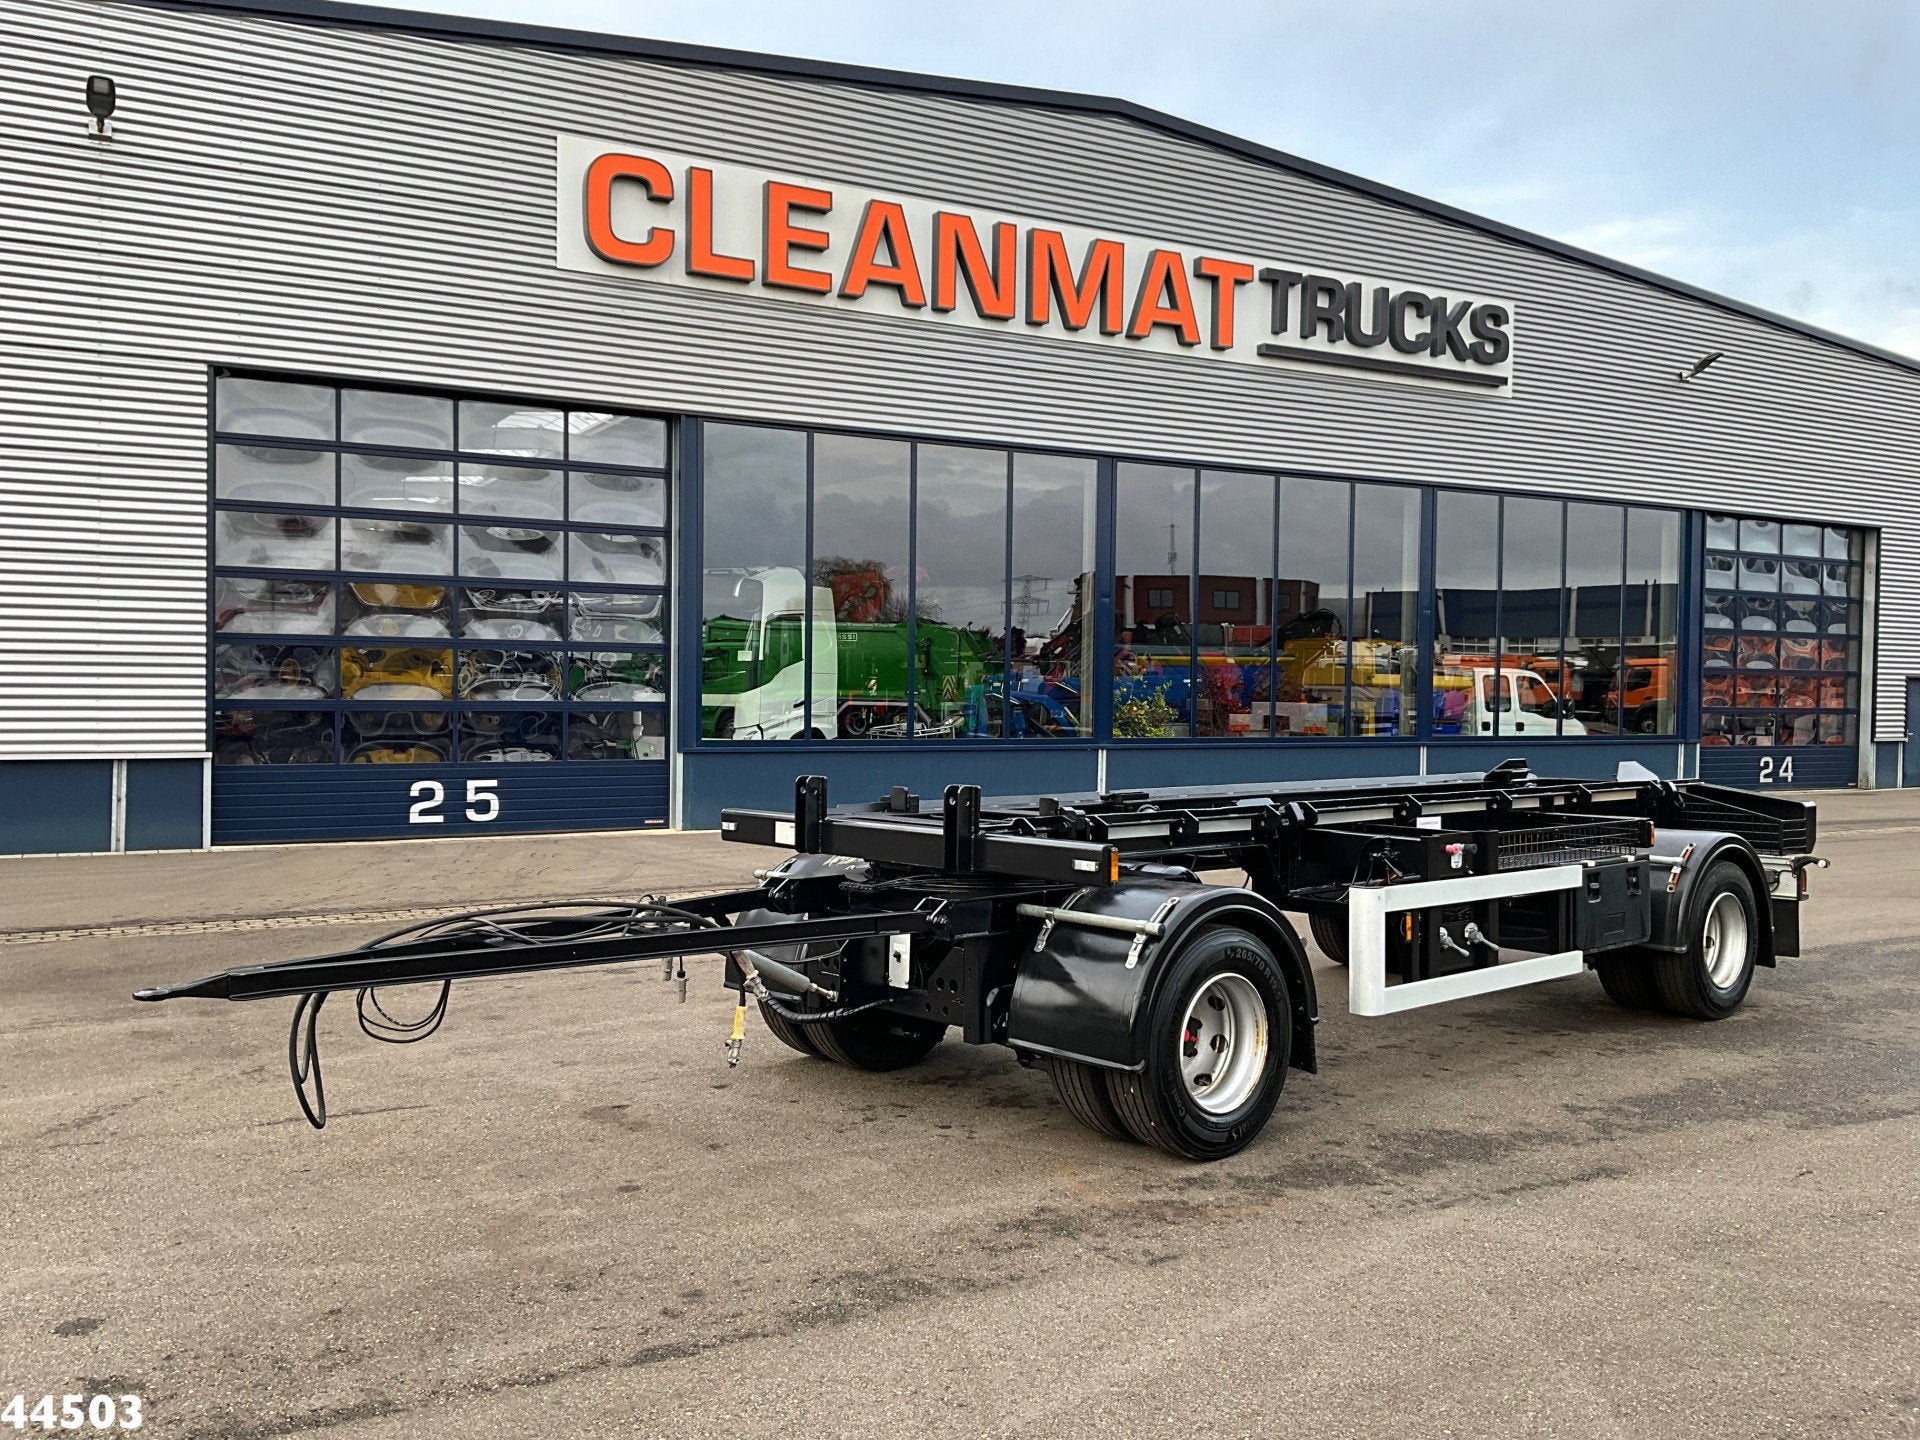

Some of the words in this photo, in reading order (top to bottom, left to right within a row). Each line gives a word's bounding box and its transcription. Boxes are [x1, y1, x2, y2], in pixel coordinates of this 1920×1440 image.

[583, 152, 1254, 350] CLEANMAT
[1259, 267, 1510, 365] TRUCKS
[1759, 756, 1794, 783] 24
[409, 780, 500, 824] 25
